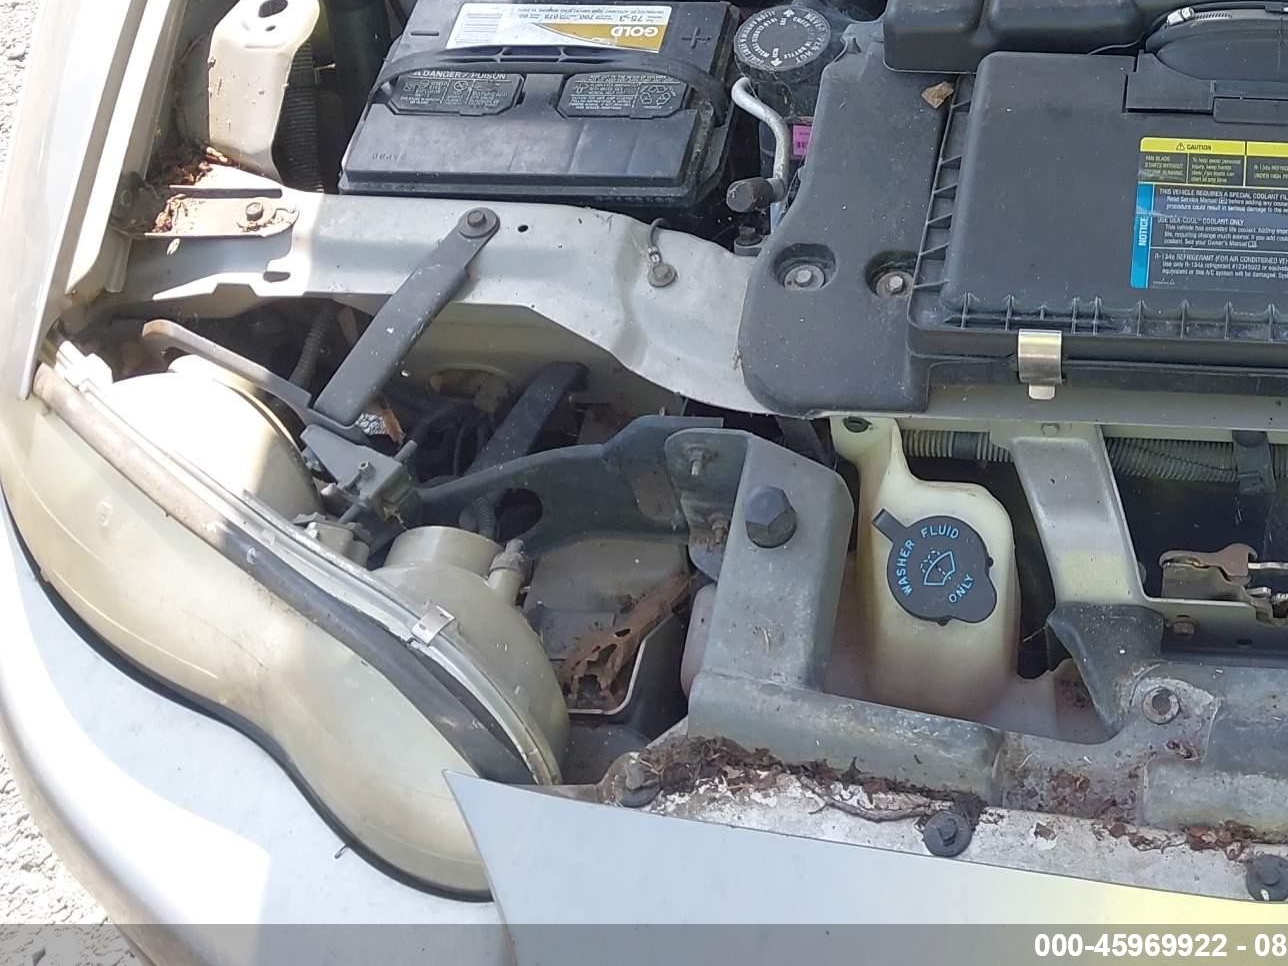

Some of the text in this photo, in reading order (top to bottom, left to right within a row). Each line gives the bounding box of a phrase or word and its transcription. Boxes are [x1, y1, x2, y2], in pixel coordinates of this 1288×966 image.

[610, 25, 659, 38] GOLD
[422, 70, 462, 79] DANGER
[1137, 216, 1149, 246] NOTICE
[1175, 253, 1214, 261] REFRIGERANT
[1239, 256, 1277, 264] CONDITIONED
[897, 524, 974, 602] WASHER FLUID ONLY
